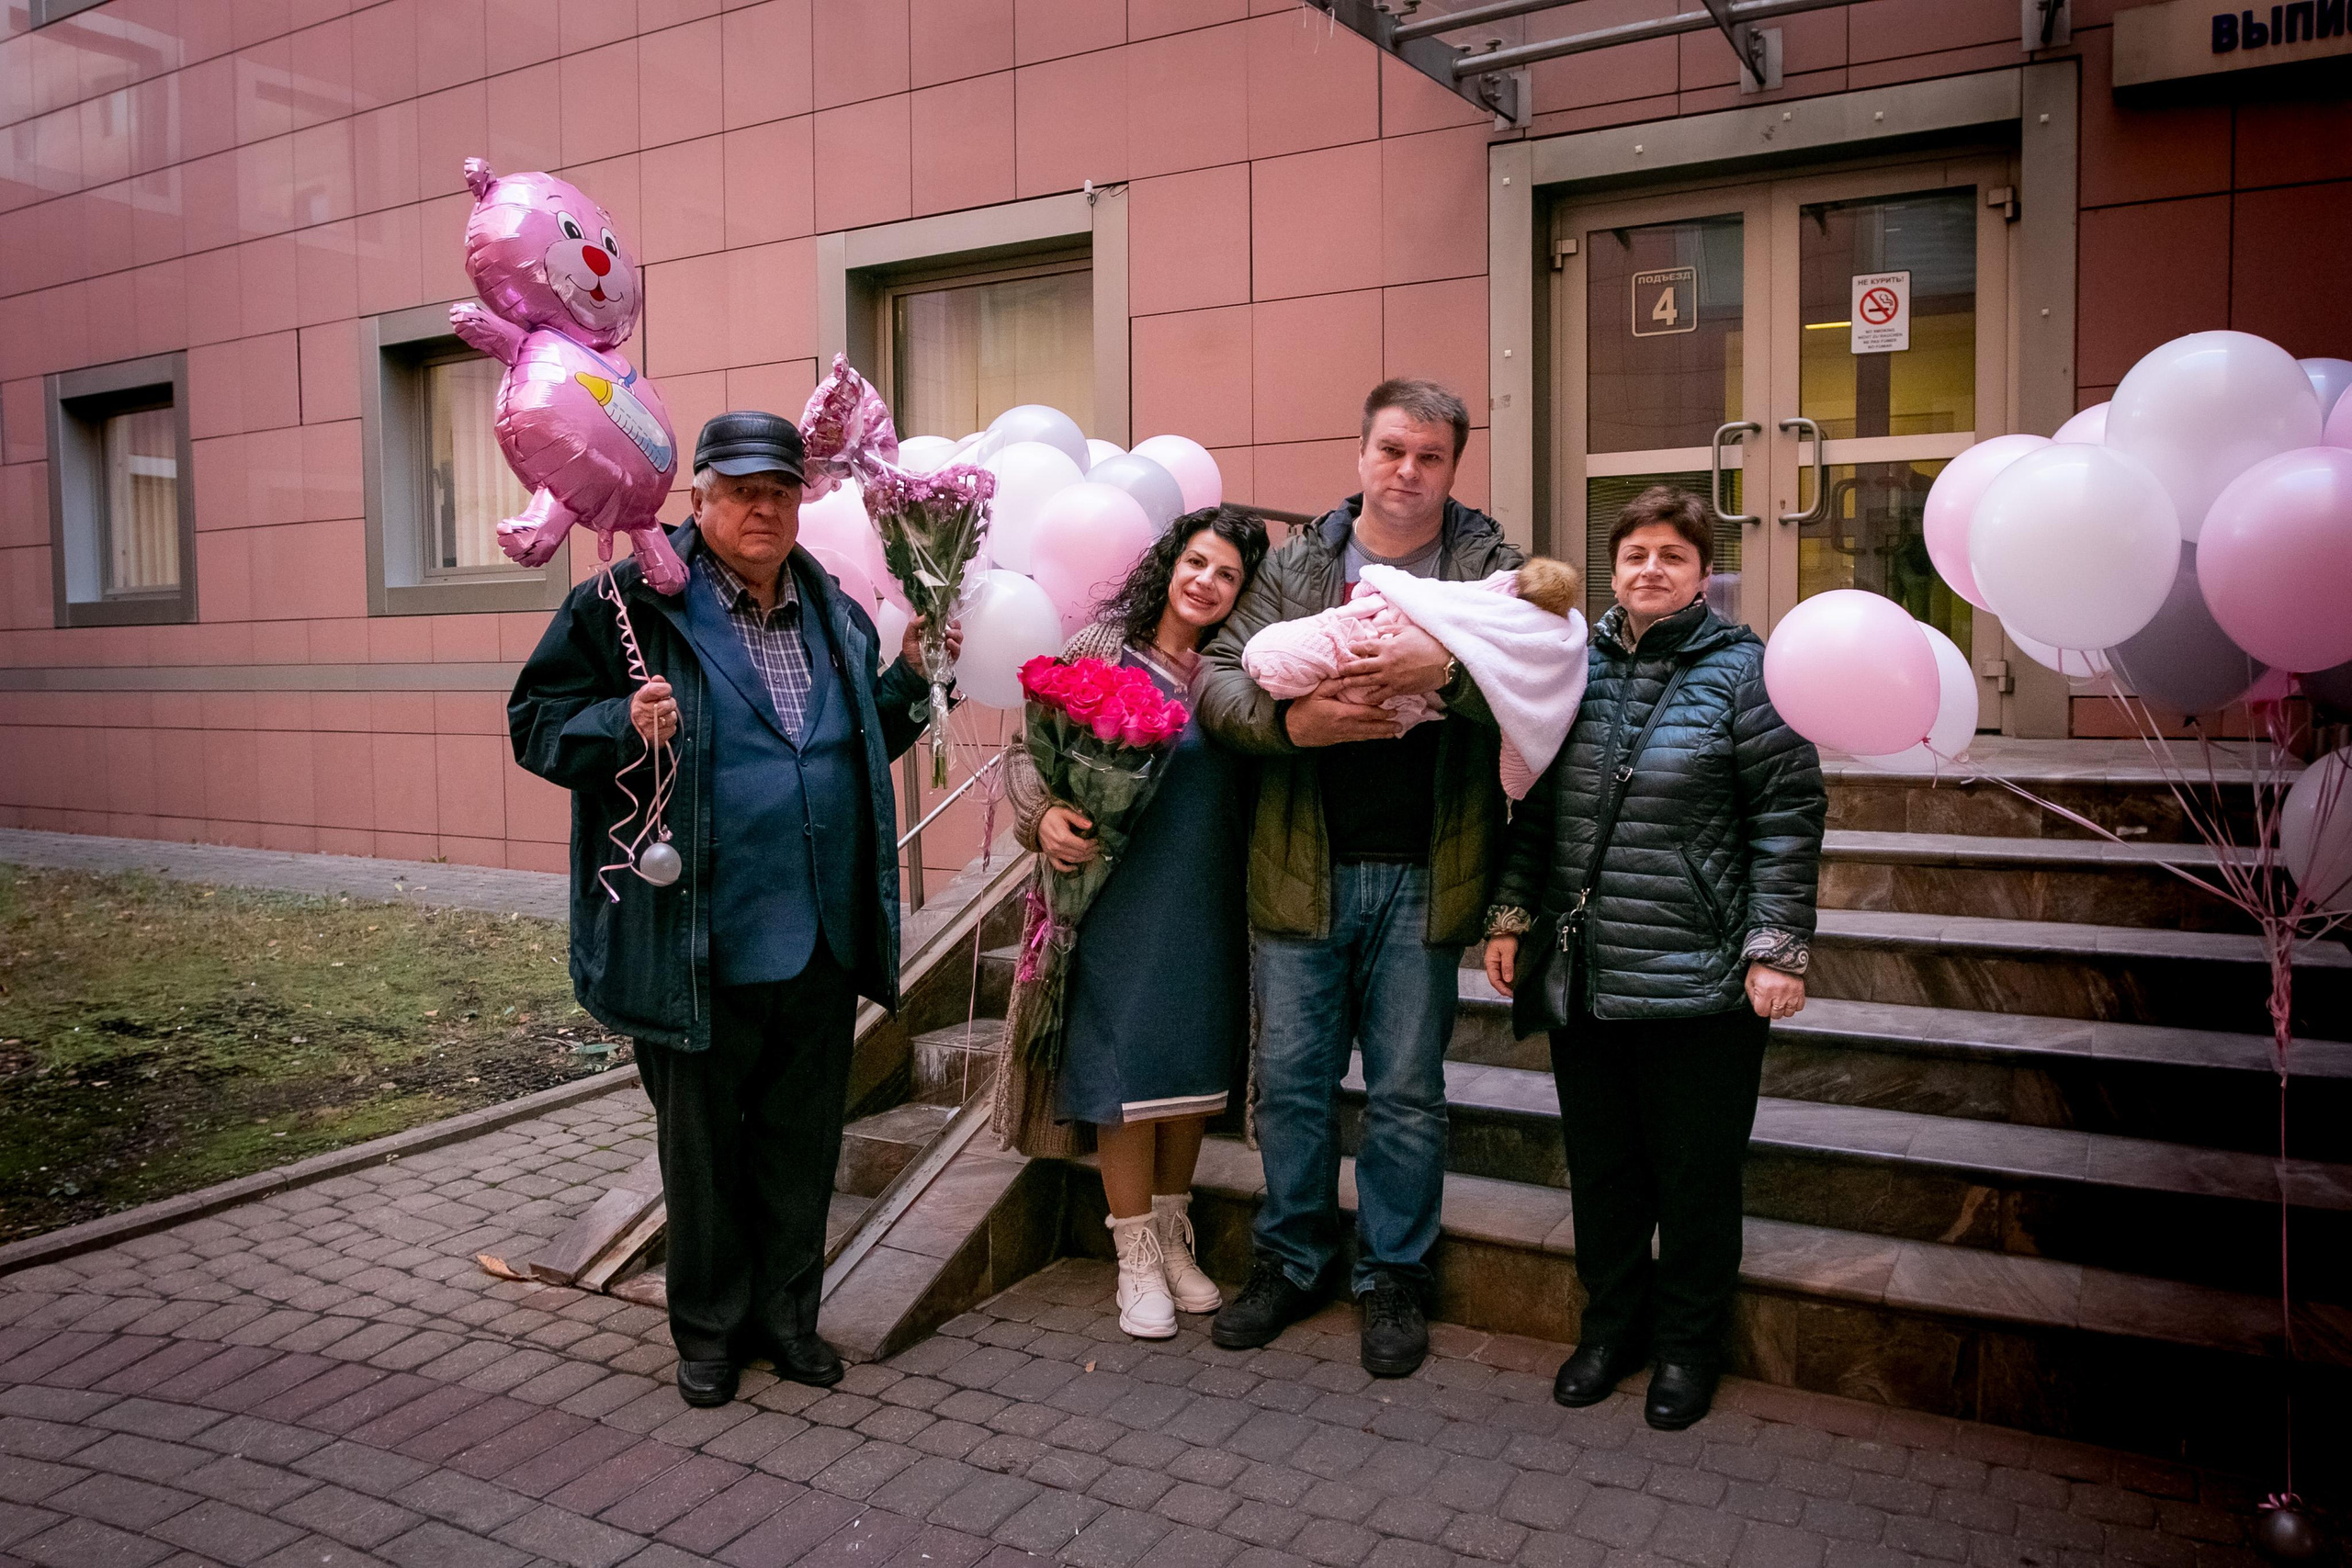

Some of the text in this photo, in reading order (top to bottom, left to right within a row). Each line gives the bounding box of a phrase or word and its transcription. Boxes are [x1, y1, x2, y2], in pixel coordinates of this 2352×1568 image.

[2212, 0, 2352, 54] ВЫПИ
[1637, 271, 1691, 285] ПОДЪЕЗД
[1871, 276, 1905, 285] КУРИТЬ!
[1652, 287, 1678, 326] 4
